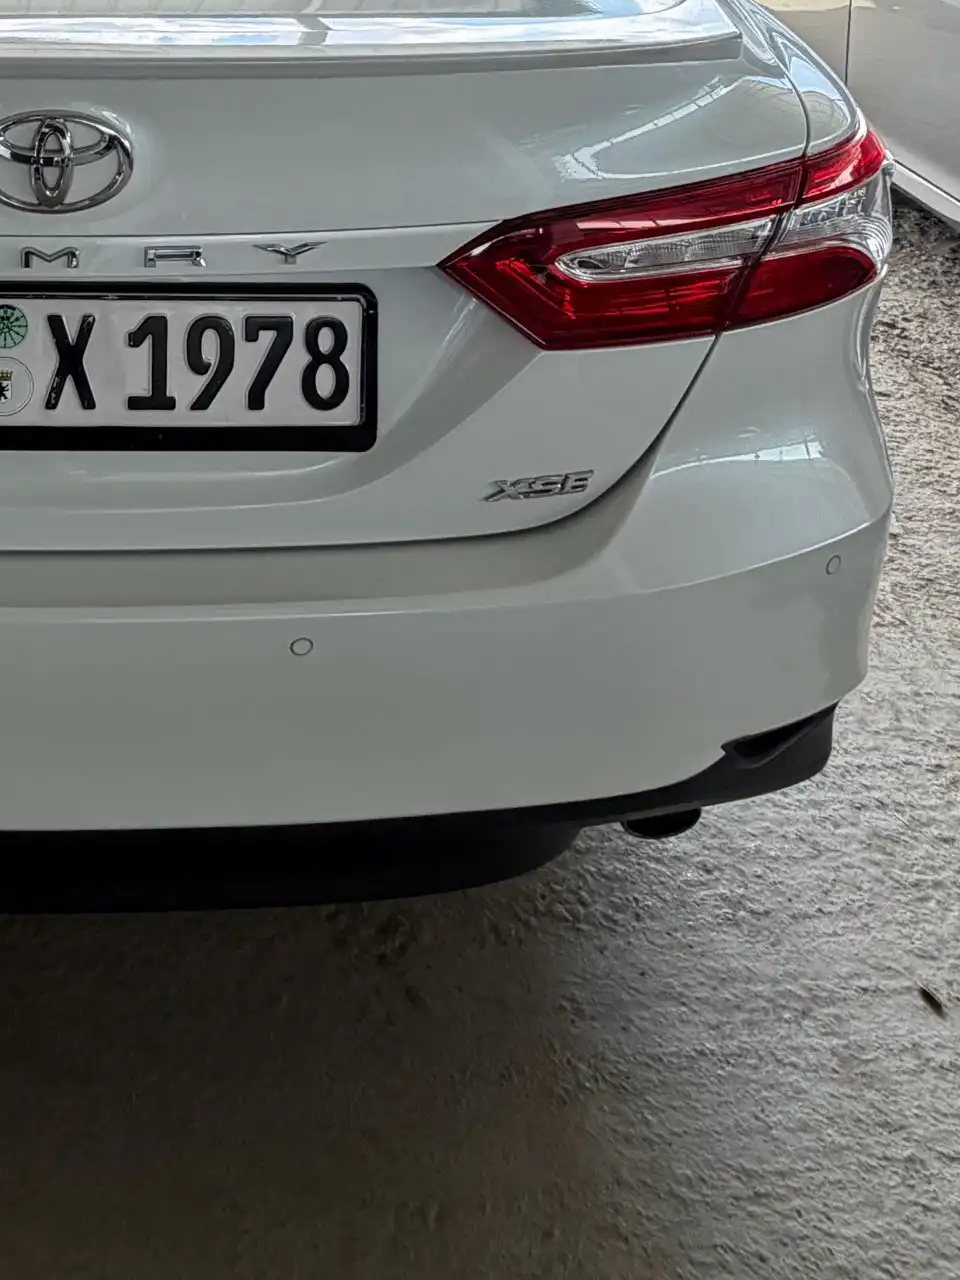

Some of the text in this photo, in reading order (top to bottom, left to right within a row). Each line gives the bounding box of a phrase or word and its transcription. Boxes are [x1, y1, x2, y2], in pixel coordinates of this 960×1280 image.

[44, 313, 97, 410] X
[126, 314, 350, 413] 1978
[481, 470, 594, 503] XSE
